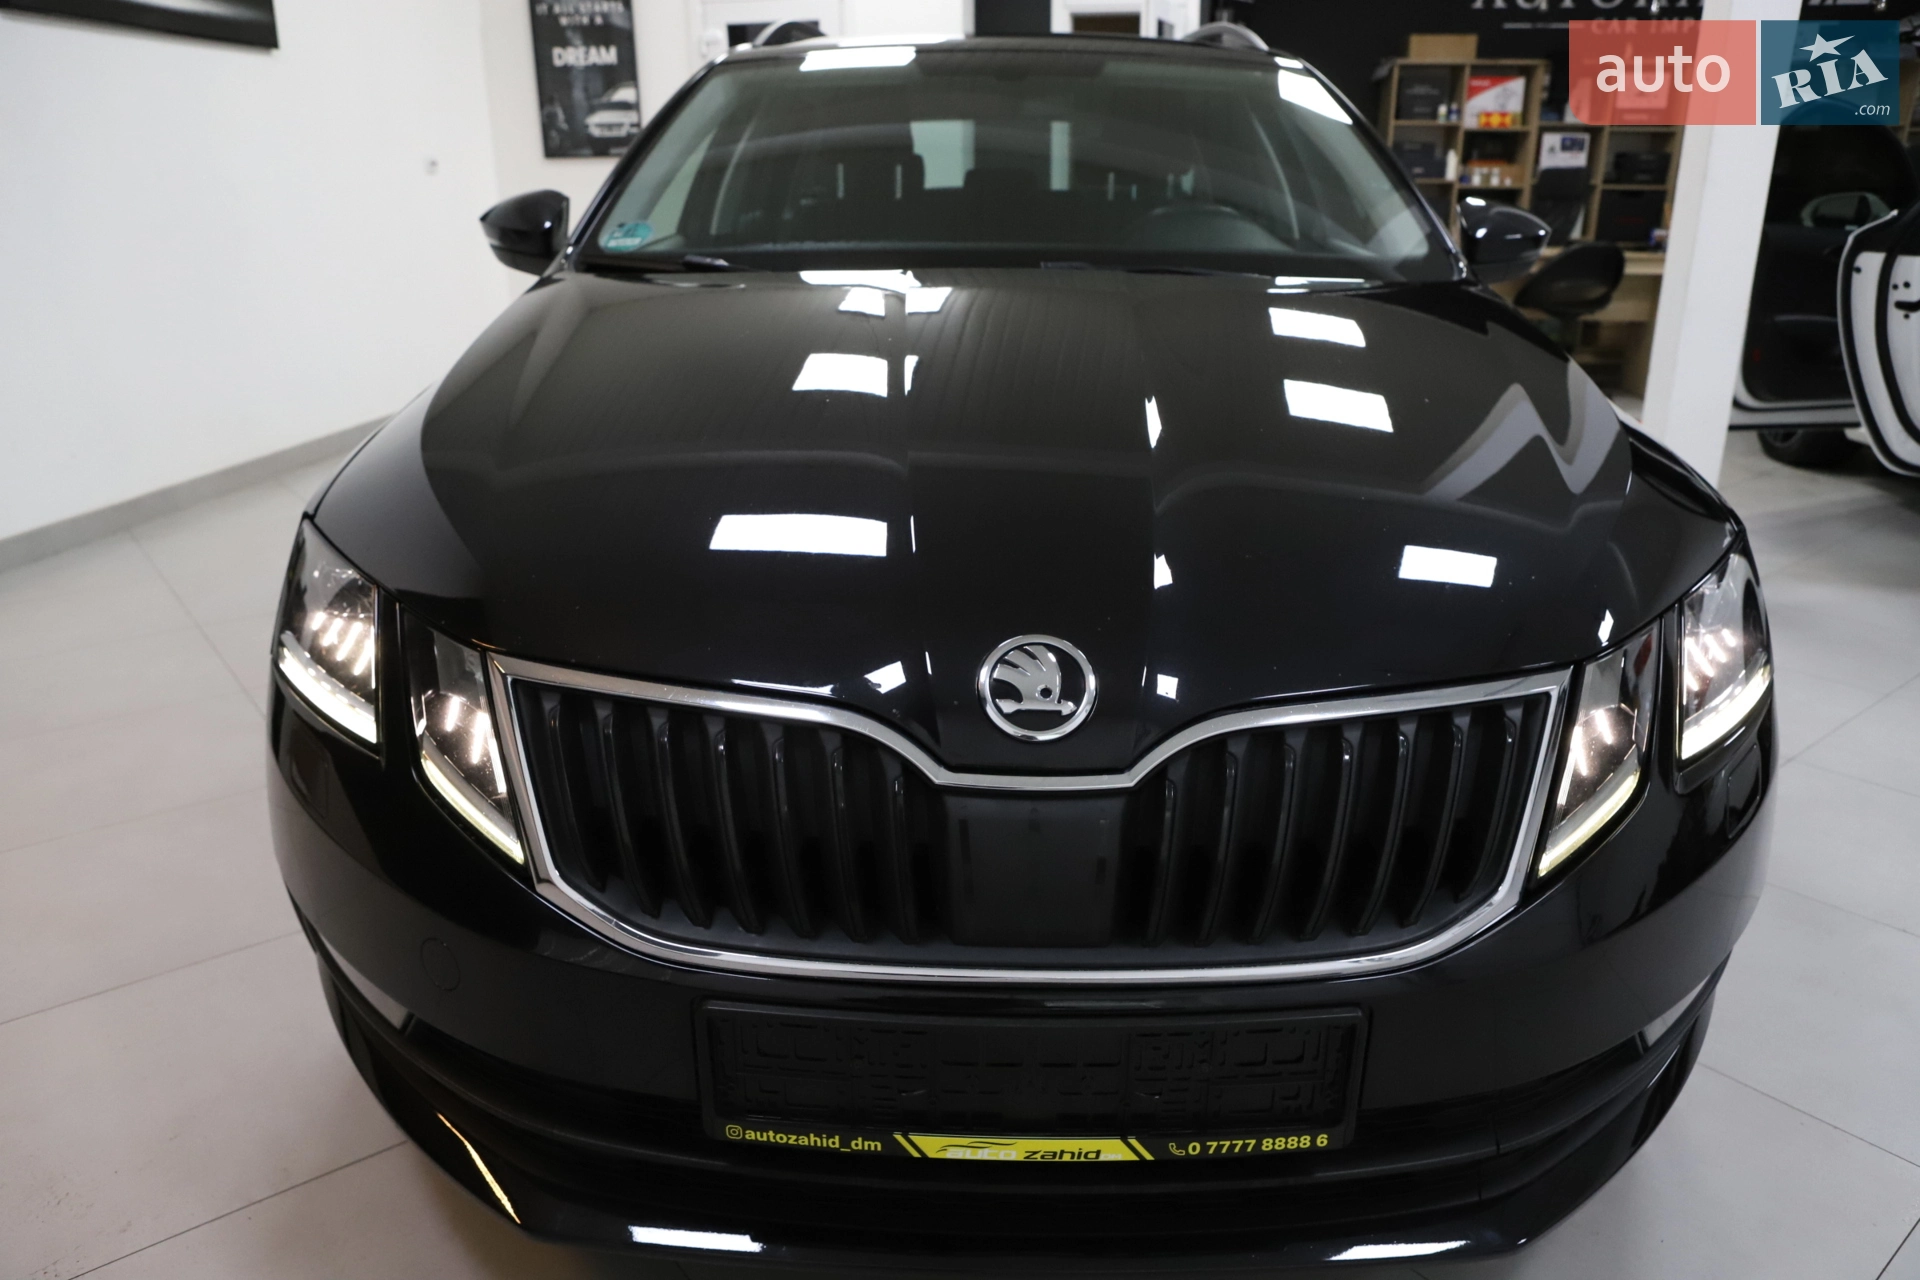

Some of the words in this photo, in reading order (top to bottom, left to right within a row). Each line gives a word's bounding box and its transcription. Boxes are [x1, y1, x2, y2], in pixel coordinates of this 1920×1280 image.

[1591, 17, 1639, 35] CAR
[1649, 16, 1700, 35] IMP
[551, 44, 618, 67] DREAM
[744, 1129, 882, 1152] autozahid_dm
[1188, 1141, 1201, 1155] 0
[1206, 1138, 1257, 1154] 7777
[1261, 1135, 1311, 1151] 8888
[1316, 1133, 1329, 1147] 6
[945, 1147, 1017, 1160] auto
[1022, 1147, 1102, 1161] zahid
